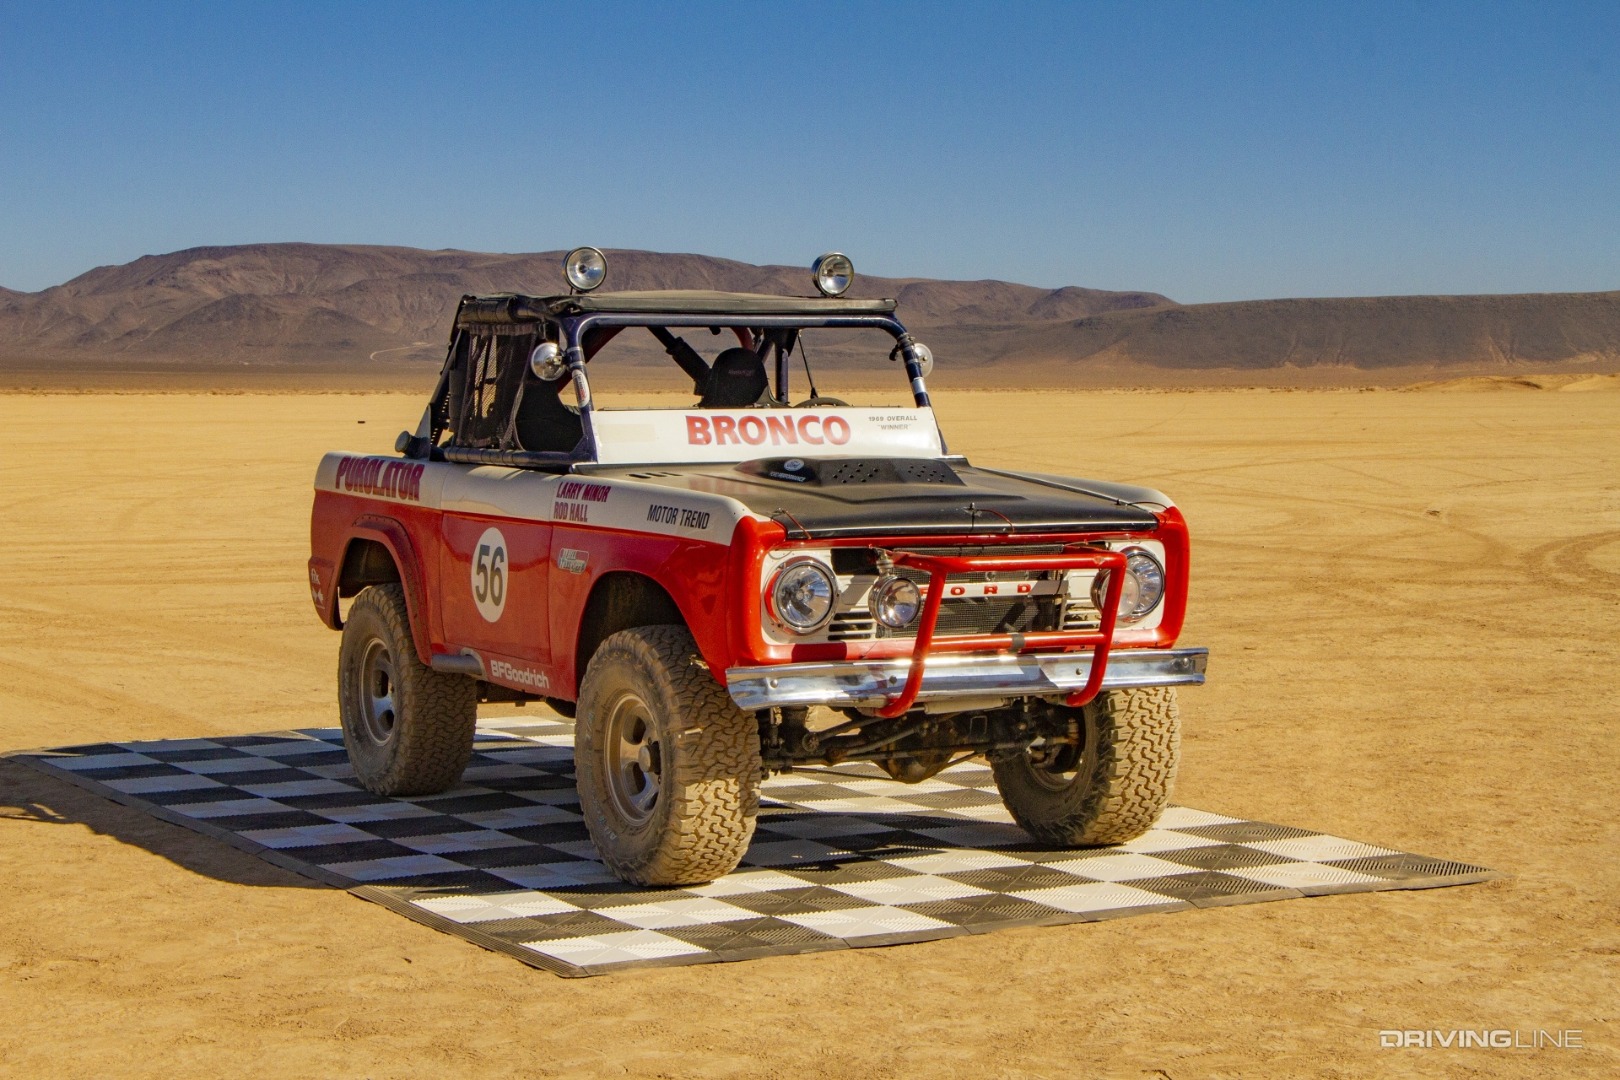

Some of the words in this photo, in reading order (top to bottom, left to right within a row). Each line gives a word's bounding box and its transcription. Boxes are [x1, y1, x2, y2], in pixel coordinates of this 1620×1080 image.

[685, 415, 852, 446] BRONCO
[335, 456, 425, 501] PUROLATOR
[556, 481, 584, 500] LARRY
[581, 483, 612, 503] MINOR
[553, 501, 569, 520] ROD
[569, 503, 589, 523] HALL
[647, 504, 680, 525] MOTOR
[679, 508, 711, 530] TREND
[475, 544, 505, 607] 56
[490, 659, 550, 689] BFGoodrich
